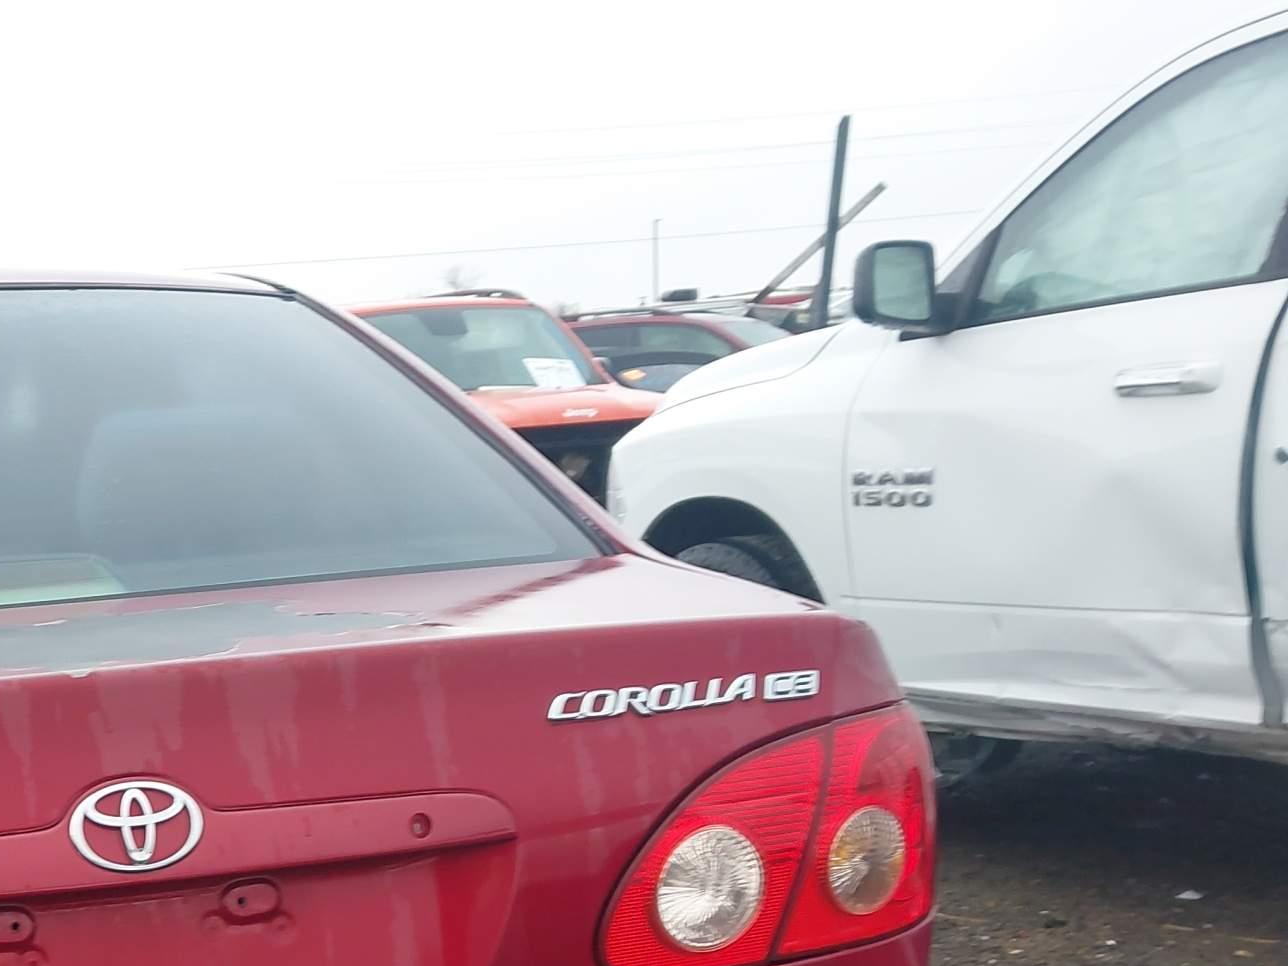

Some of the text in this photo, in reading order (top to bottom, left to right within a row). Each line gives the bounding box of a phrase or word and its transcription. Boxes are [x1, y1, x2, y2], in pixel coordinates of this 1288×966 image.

[852, 470, 934, 486] RAM
[852, 490, 932, 508] 1500
[547, 672, 757, 720] COROLLA
